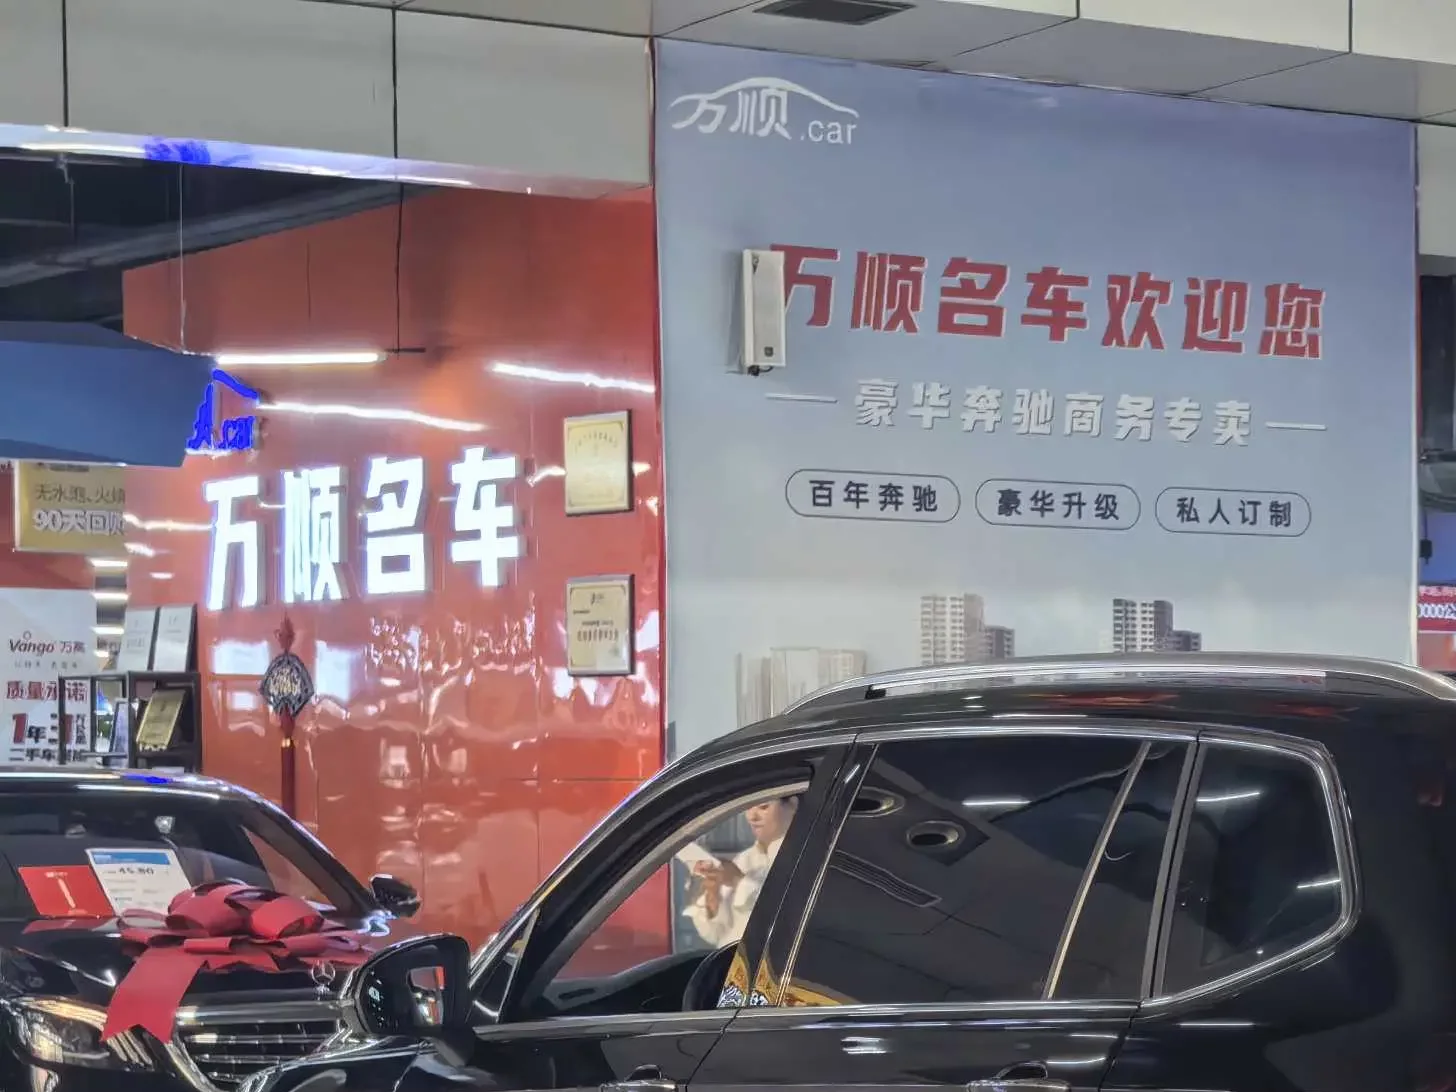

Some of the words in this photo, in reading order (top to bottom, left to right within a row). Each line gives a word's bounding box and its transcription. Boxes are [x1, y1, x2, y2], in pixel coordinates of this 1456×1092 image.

[770, 243, 1326, 360] 万顺名车欢迎您
[854, 376, 1254, 447] 豪华奔驰商务专卖
[808, 478, 940, 514] 百年奔驰
[995, 487, 1121, 522] 豪华升级
[1175, 495, 1294, 529] 私人订制
[204, 446, 522, 611] 万顺名车
